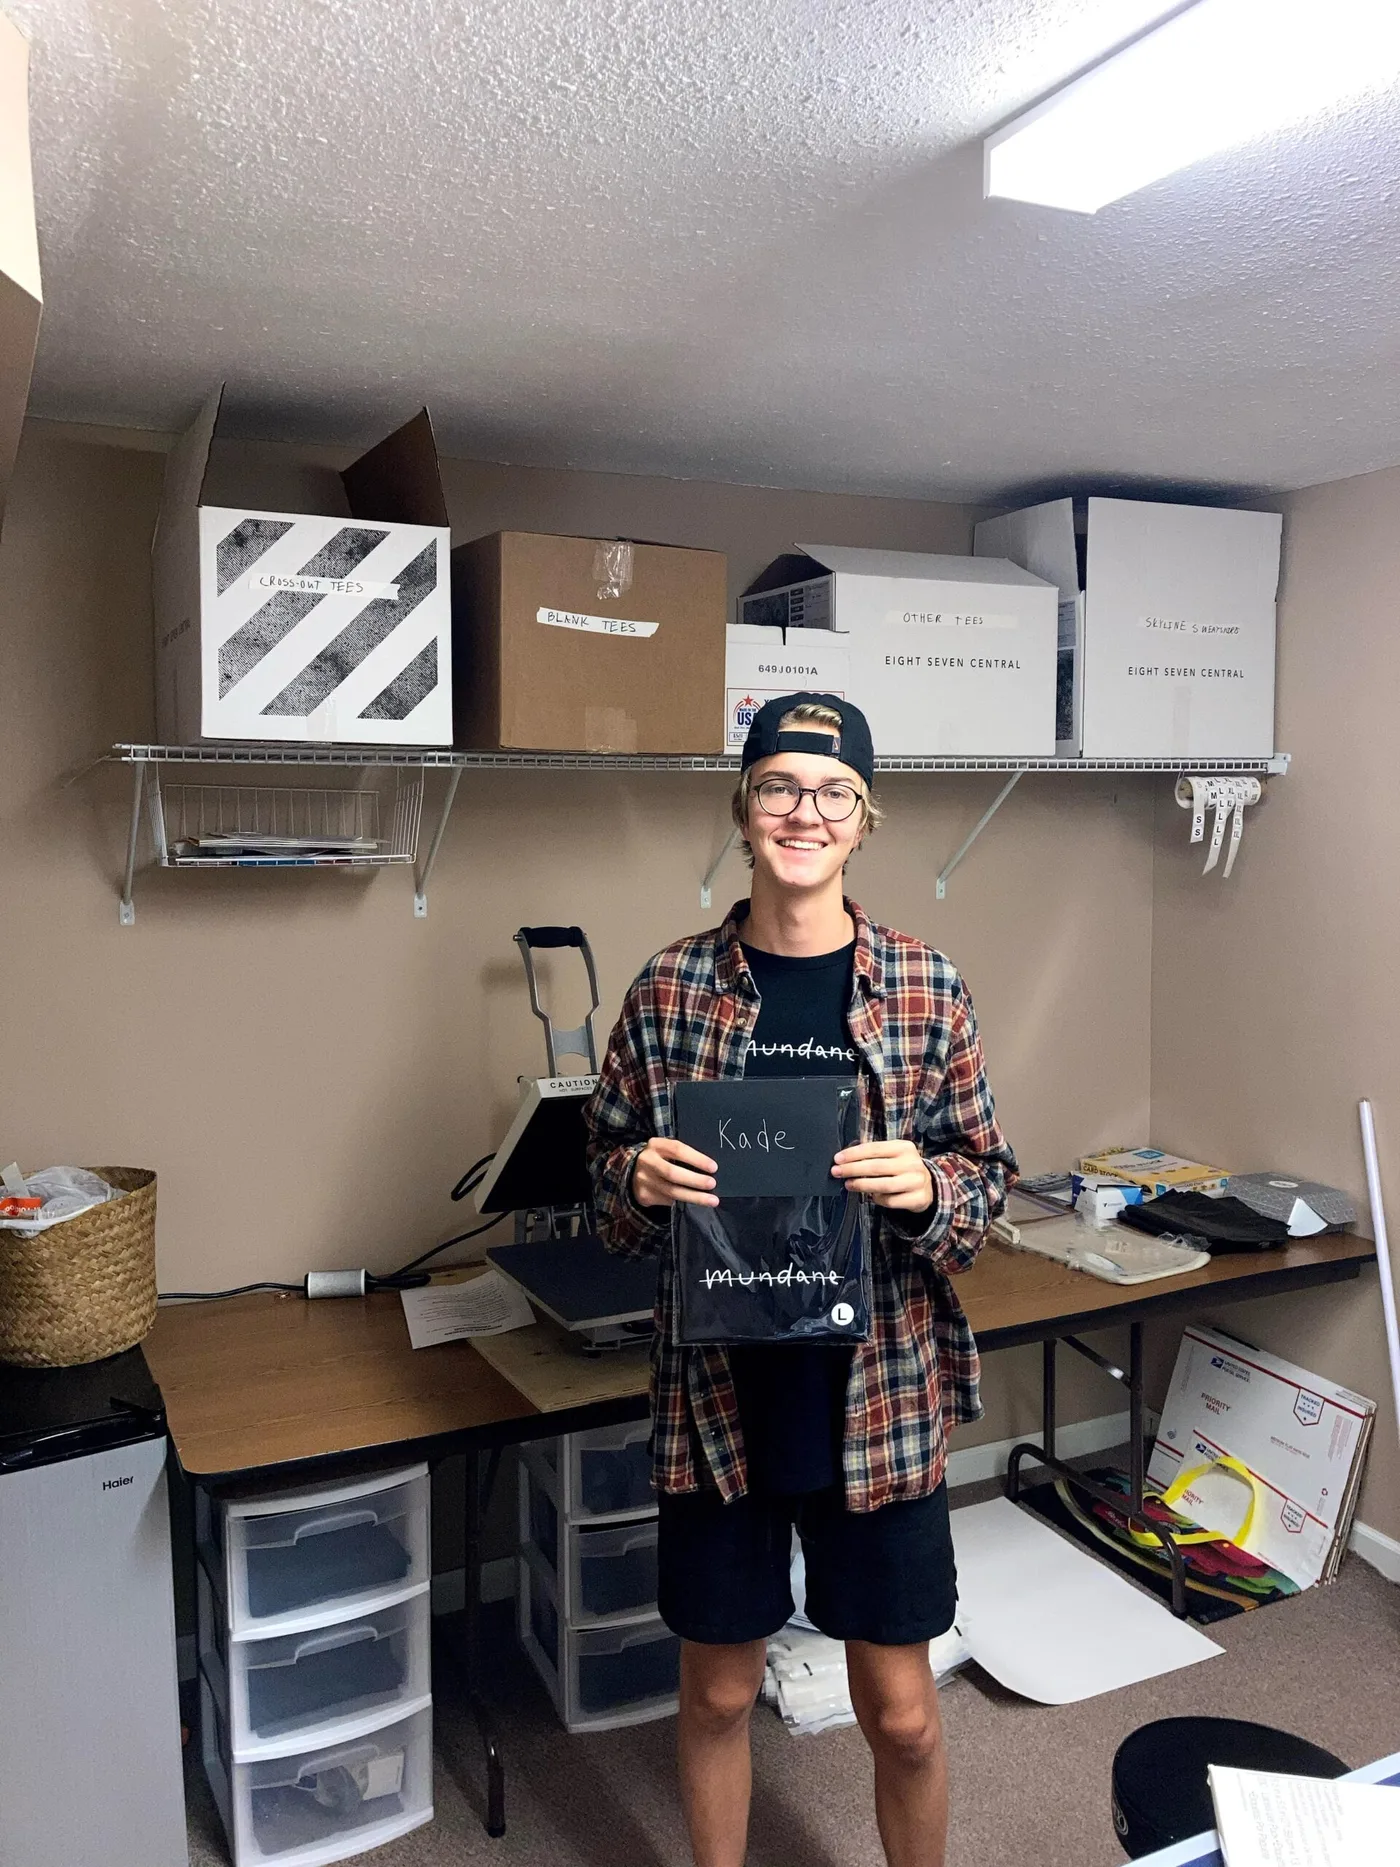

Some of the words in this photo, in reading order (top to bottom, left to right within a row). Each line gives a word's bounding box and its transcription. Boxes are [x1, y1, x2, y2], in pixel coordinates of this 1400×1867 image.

[330, 580, 365, 593] TEES
[547, 611, 590, 627] BLANK
[601, 620, 637, 633] TEES
[902, 612, 943, 624] OTHER
[954, 615, 984, 626] TEES
[1145, 616, 1187, 631] SKYLINE
[885, 655, 922, 666] EIGHT
[927, 656, 965, 668] SEVEN
[970, 658, 1021, 670] CENTRAL
[758, 664, 818, 676] 649J0101A
[1128, 666, 1160, 677] EIGHT
[1164, 667, 1197, 678] SEVEN
[1200, 668, 1245, 679] CENTRAL
[737, 711, 754, 726] US
[550, 1078, 598, 1089] CAUTION
[718, 1117, 795, 1153] Kade
[837, 1308, 847, 1321] L
[1201, 1392, 1231, 1412] PRIORITY
[1205, 1402, 1220, 1415] MAIL
[102, 1475, 134, 1491] Haier
